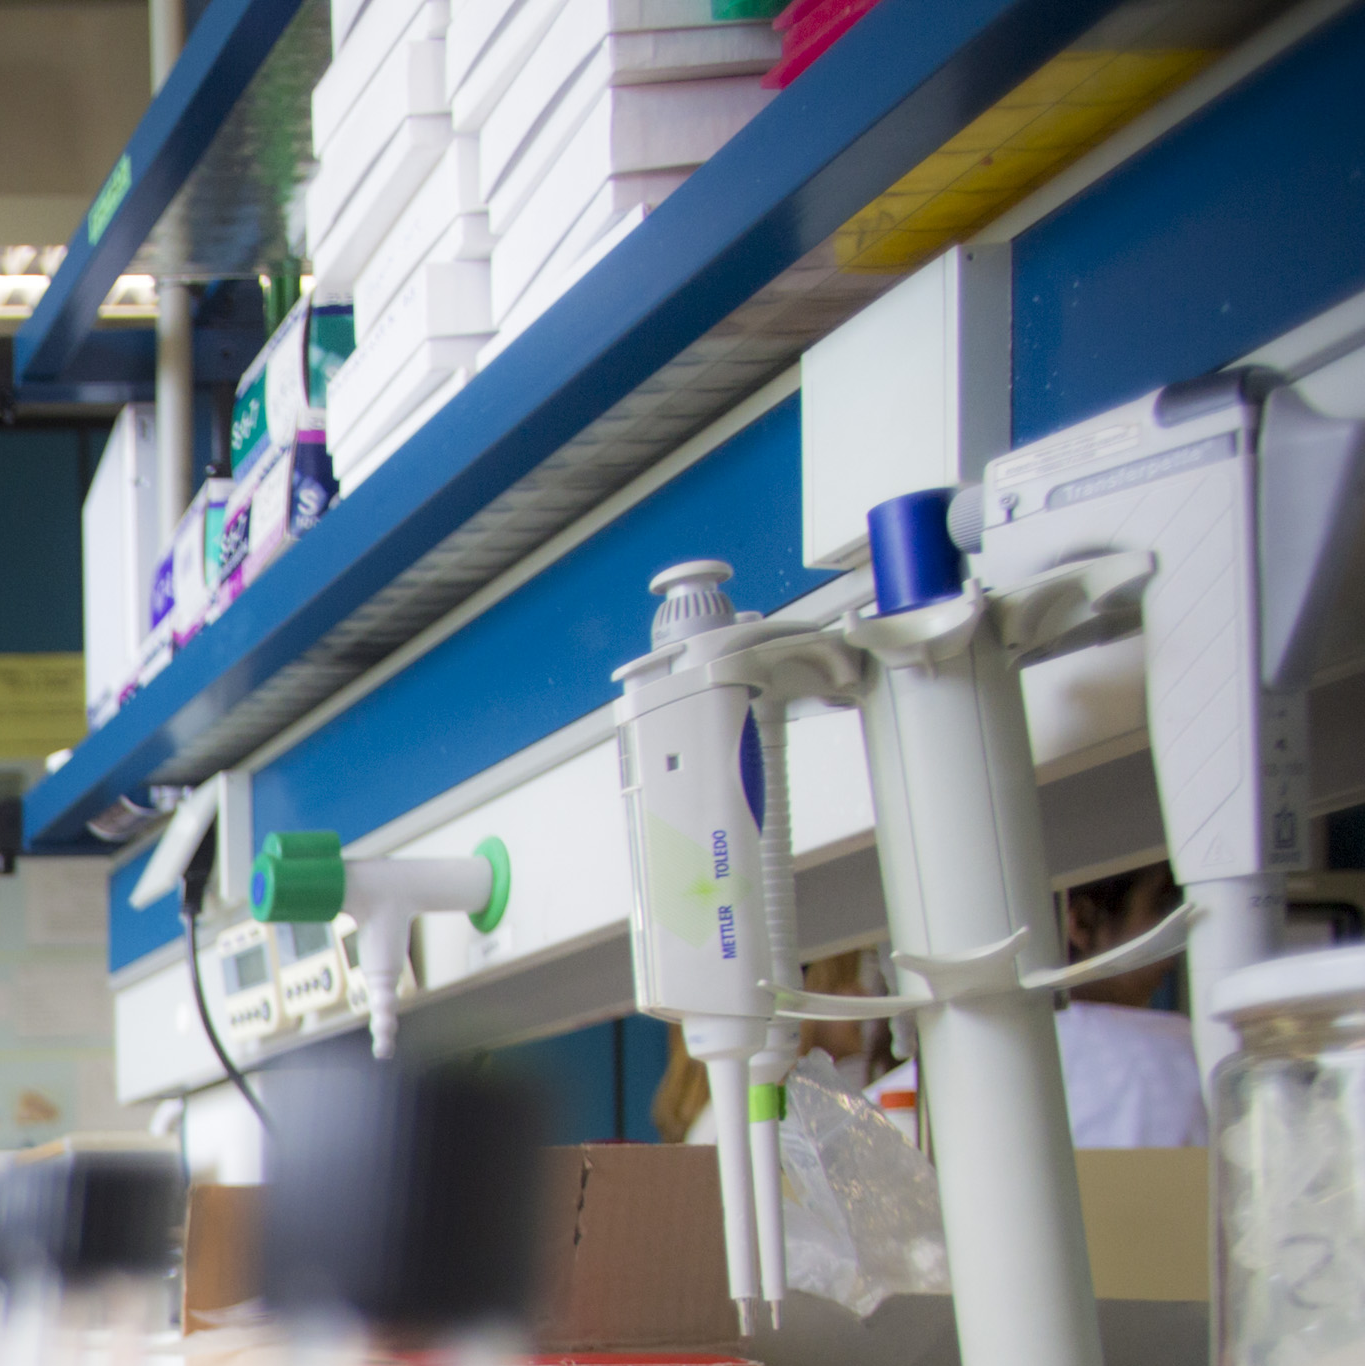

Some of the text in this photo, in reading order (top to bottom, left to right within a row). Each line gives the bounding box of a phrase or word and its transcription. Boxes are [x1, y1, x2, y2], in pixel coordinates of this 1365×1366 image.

[296, 489, 319, 516] S
[712, 829, 737, 959] METTLER TOLEDO
